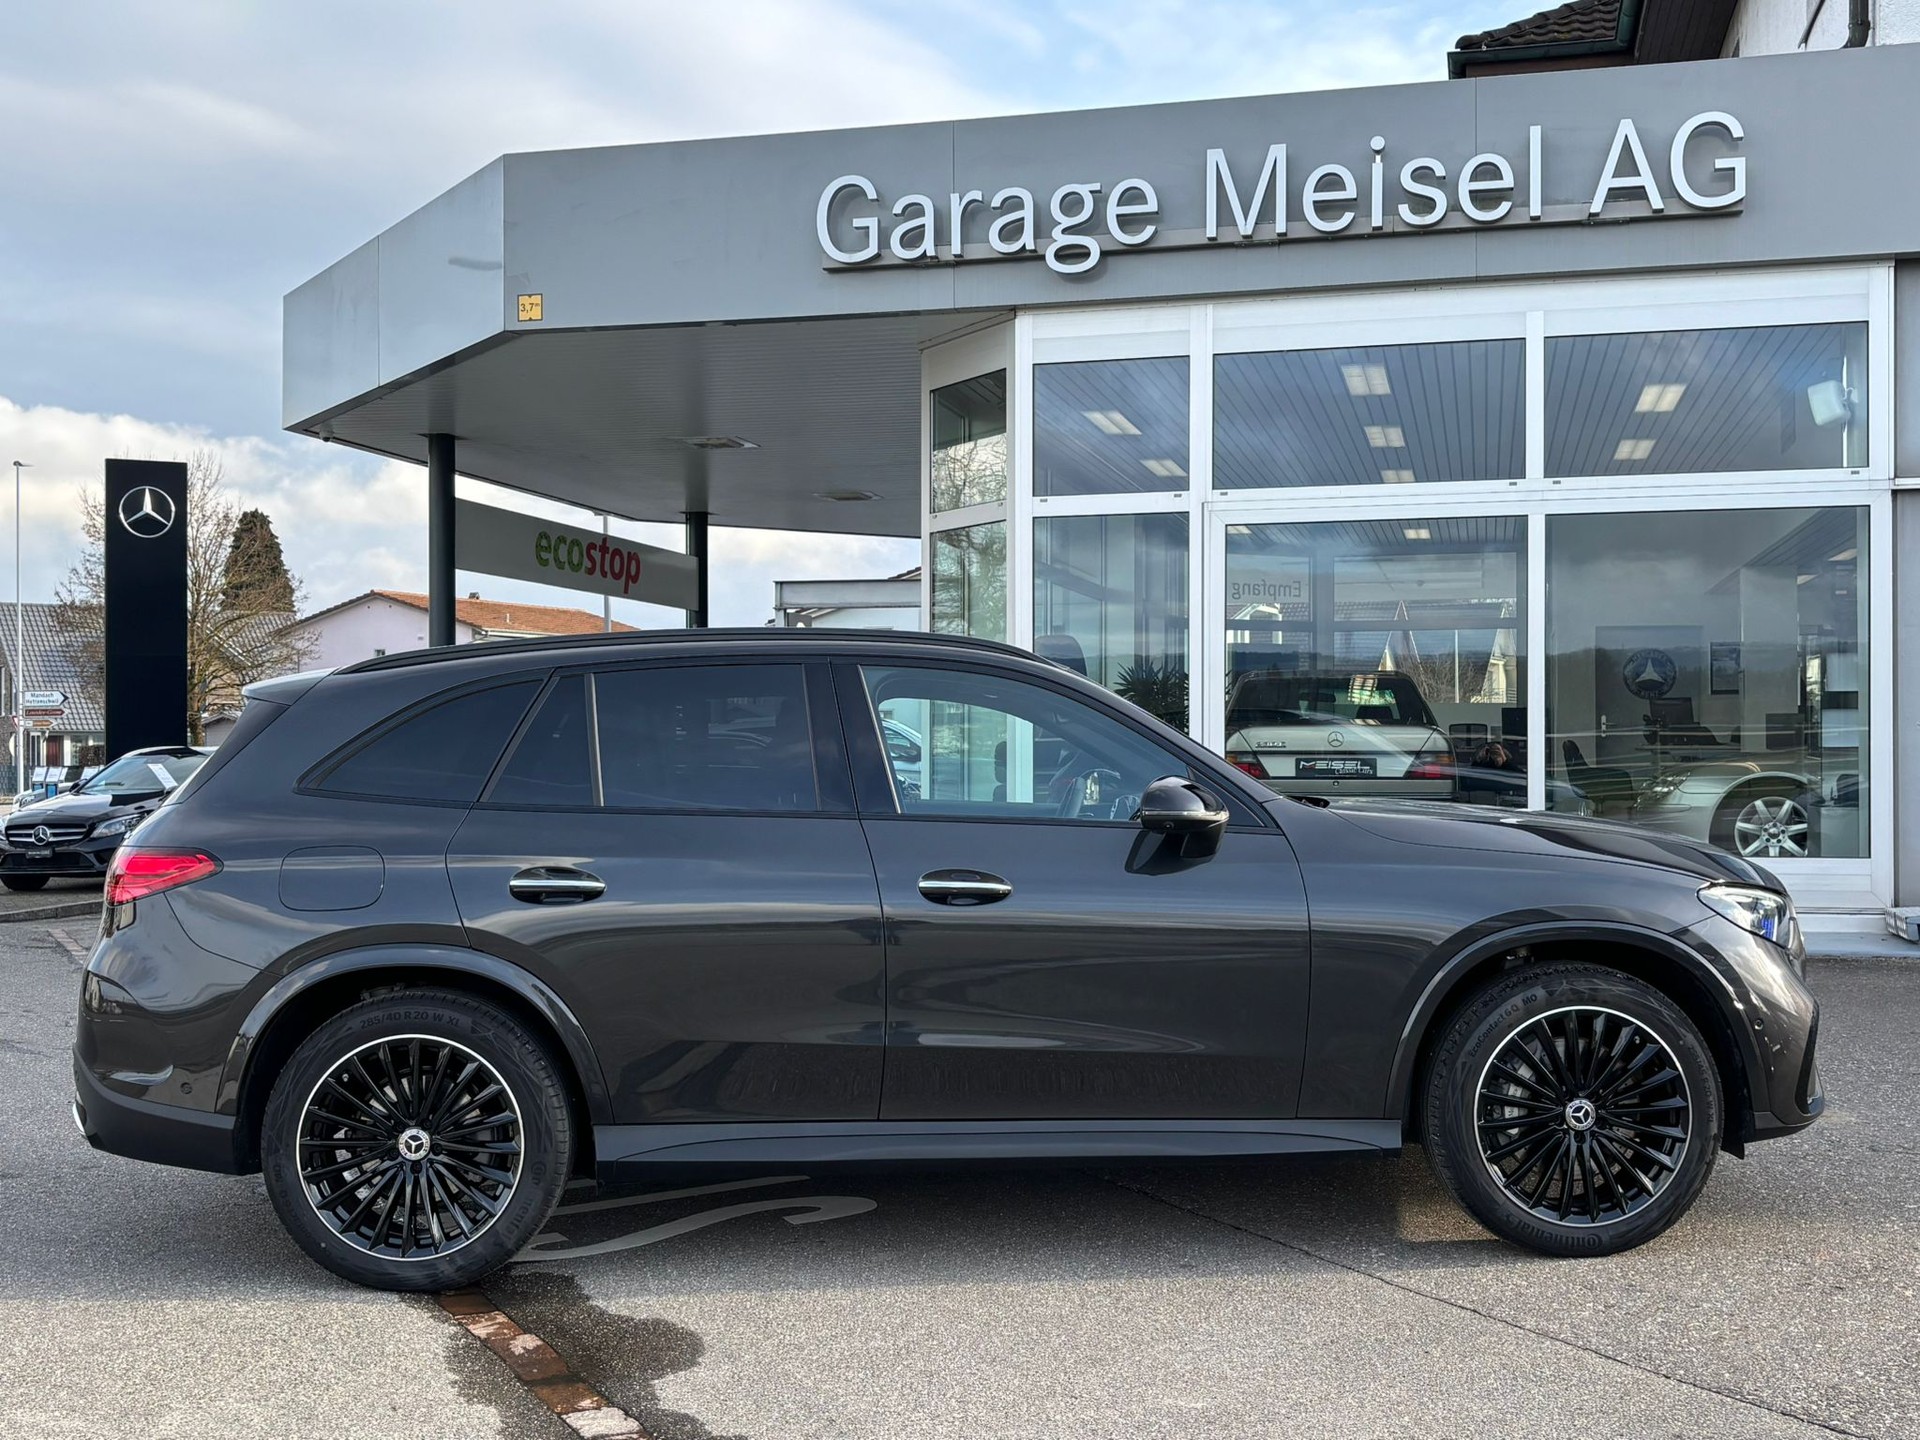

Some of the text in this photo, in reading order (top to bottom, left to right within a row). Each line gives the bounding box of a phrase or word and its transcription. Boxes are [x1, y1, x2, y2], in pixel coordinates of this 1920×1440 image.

[816, 111, 1748, 274] Garage Meisel AG
[535, 530, 641, 594] ecostop
[1299, 760, 1370, 769] MEISEL
[1522, 993, 1538, 1006] MO
[360, 1011, 400, 1029] 285/40
[433, 1012, 444, 1022] W
